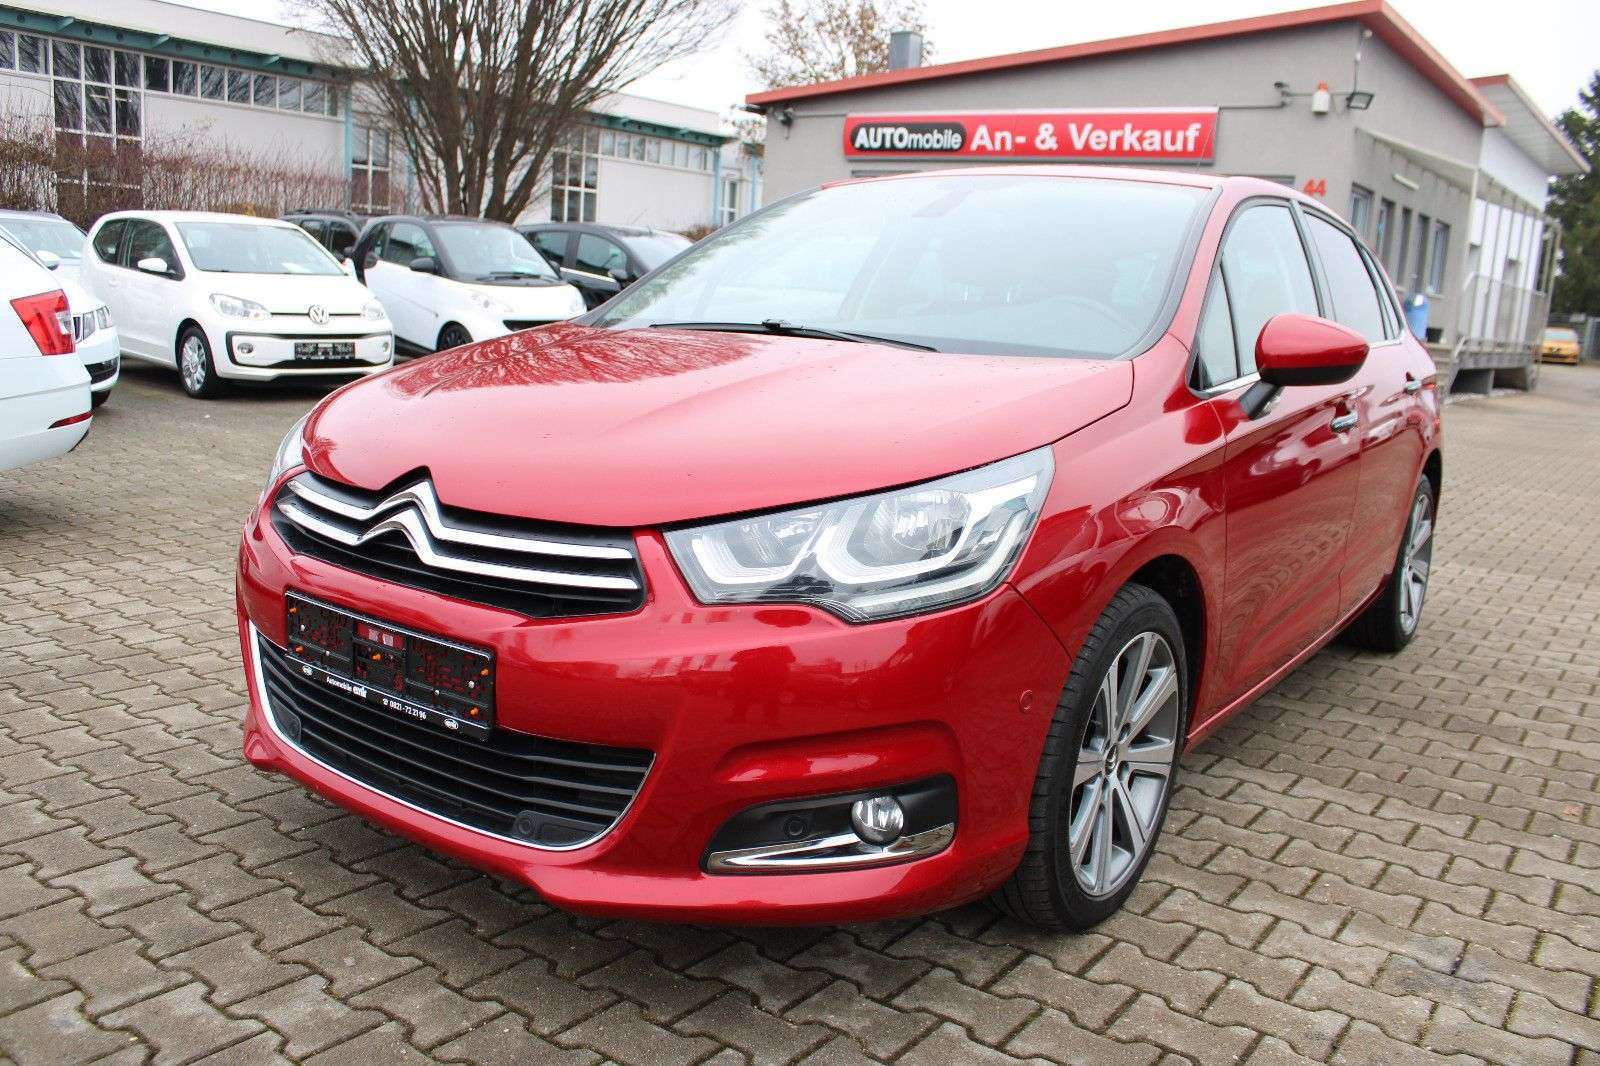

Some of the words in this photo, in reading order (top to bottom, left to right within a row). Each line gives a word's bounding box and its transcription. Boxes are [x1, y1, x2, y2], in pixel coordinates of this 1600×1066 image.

[854, 127, 963, 150] AUTOmobile
[969, 124, 1027, 152] An-
[1034, 122, 1059, 151] &
[1068, 122, 1202, 152] Verkauf
[1303, 177, 1327, 198] 44
